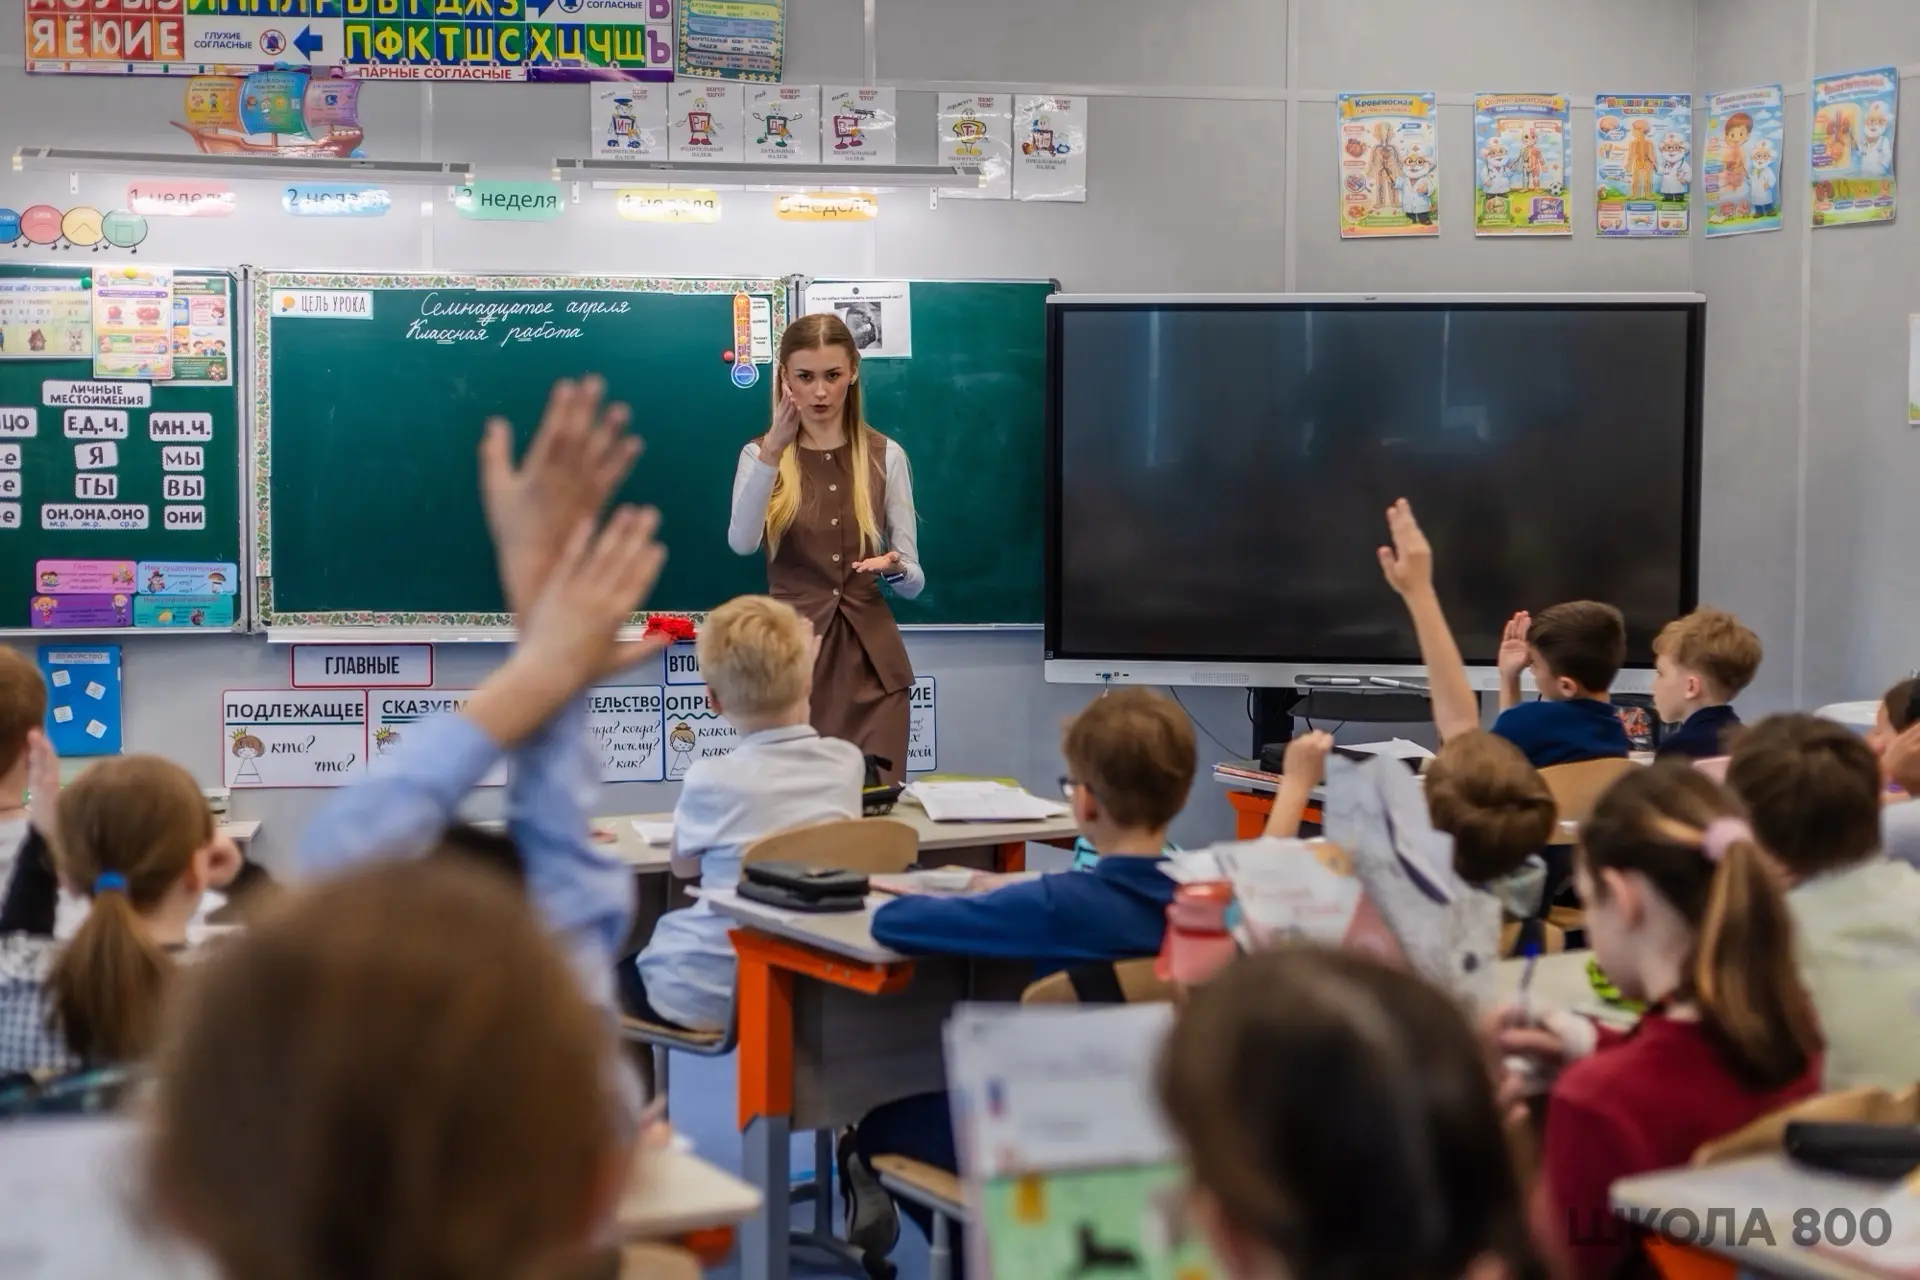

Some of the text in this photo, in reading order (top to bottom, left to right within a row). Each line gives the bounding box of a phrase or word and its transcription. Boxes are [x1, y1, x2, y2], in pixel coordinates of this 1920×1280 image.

[586, 0, 643, 9] СОГЛАСНЫЕ
[204, 31, 242, 41] ГЛУХИЕ
[194, 40, 253, 50] СОГЛАСНЫЕ
[358, 67, 512, 80] ПАРНЫЕ СОГЛАСНЫЕ
[287, 188, 298, 207] 2
[481, 193, 557, 211] неделя
[301, 295, 366, 313] ЦЕЛЬ УРОКА
[421, 292, 631, 323] Семнадцатое апреля
[405, 320, 585, 347] Классная работа
[70, 384, 123, 395] ЛИЧНЫЕ
[50, 394, 144, 405] МЕСТОИМЕНИЯ
[0, 415, 30, 432] ЦО
[152, 420, 211, 436] МН.Ч.
[89, 446, 104, 465] Я
[165, 450, 201, 466] МЫ
[78, 477, 114, 496] ТЫ
[167, 480, 202, 497] ВЫ
[166, 510, 203, 524] ОНИ
[325, 656, 400, 675] ГЛАВНЫЕ
[909, 687, 931, 701] ИЕ
[226, 703, 364, 721] ПОДЛЕЖАЩЕЕ
[382, 699, 468, 715] СКАЗУЕМ
[590, 719, 661, 740] уда? когда?
[271, 735, 316, 754] кто?
[613, 737, 660, 757] почему?
[314, 753, 356, 772] что?
[616, 755, 646, 769] как?
